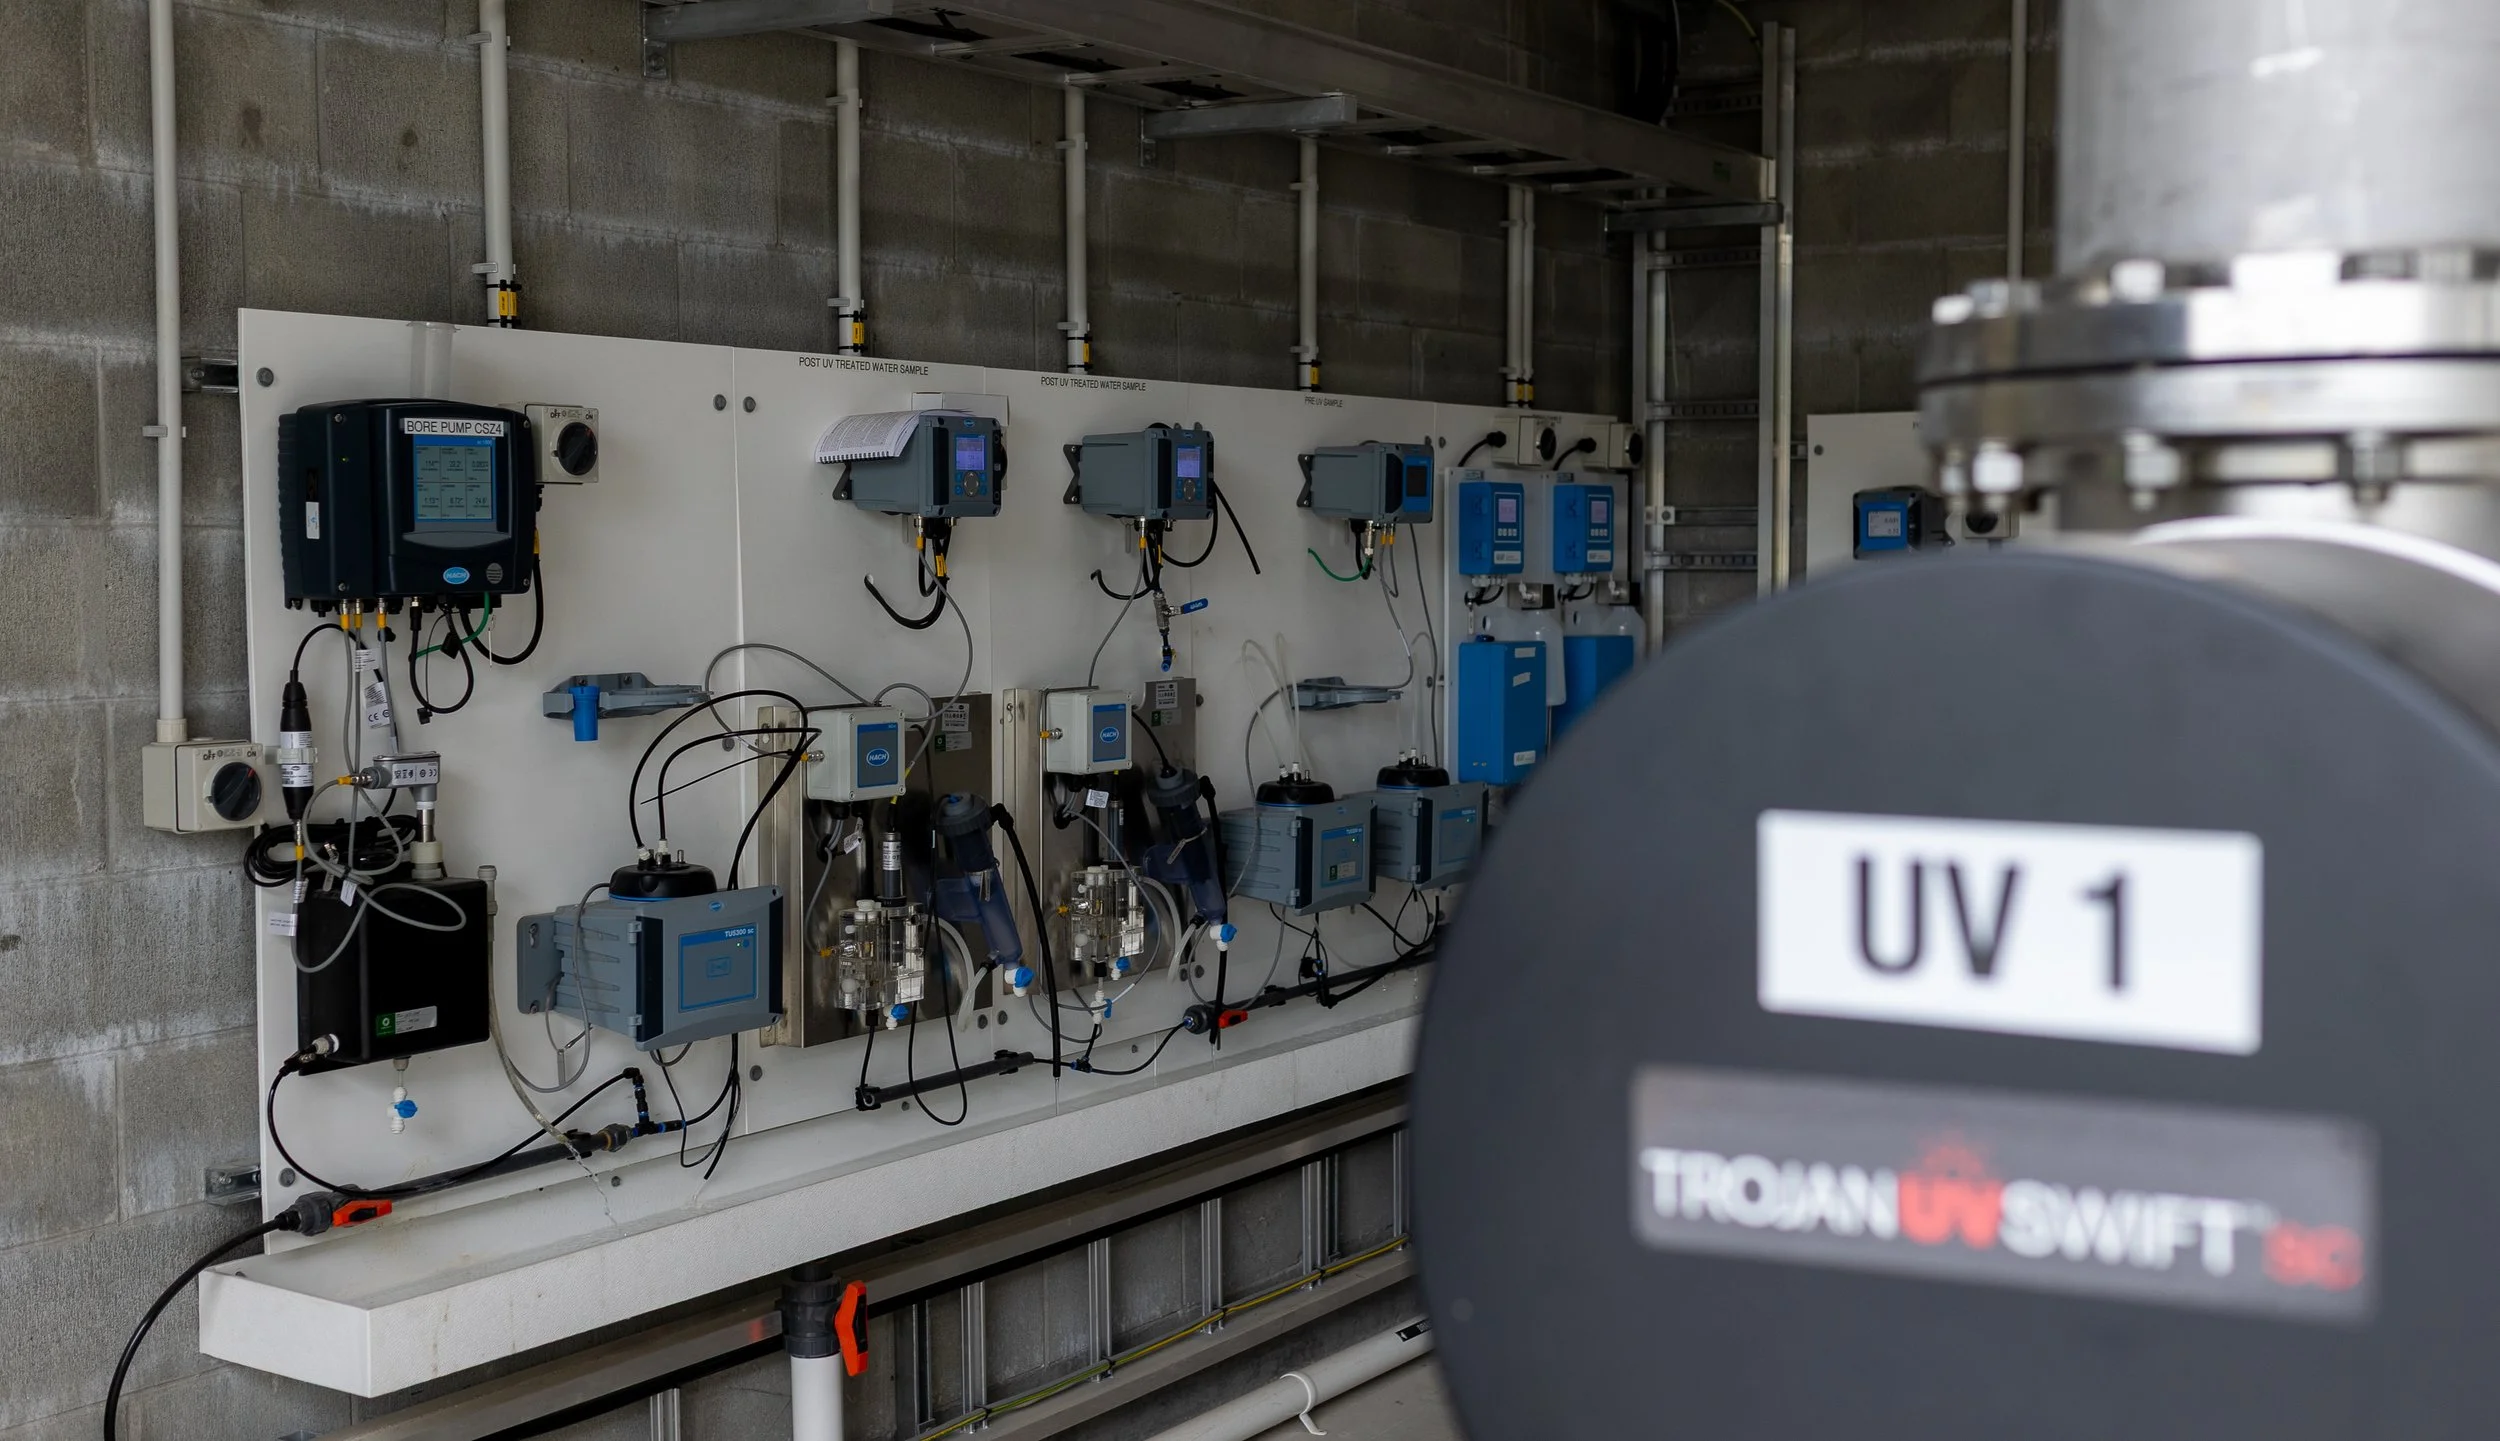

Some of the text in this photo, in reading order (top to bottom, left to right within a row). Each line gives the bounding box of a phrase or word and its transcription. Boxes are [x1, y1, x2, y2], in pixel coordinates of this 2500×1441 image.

[799, 357, 928, 375] POST UV TREATED WATER SAMPLE
[1041, 377, 1146, 391] POST UV TREATED WATER SAMPLE
[407, 421, 502, 434] BORE PUMP CSZ4
[1852, 853, 2131, 997] UV 1
